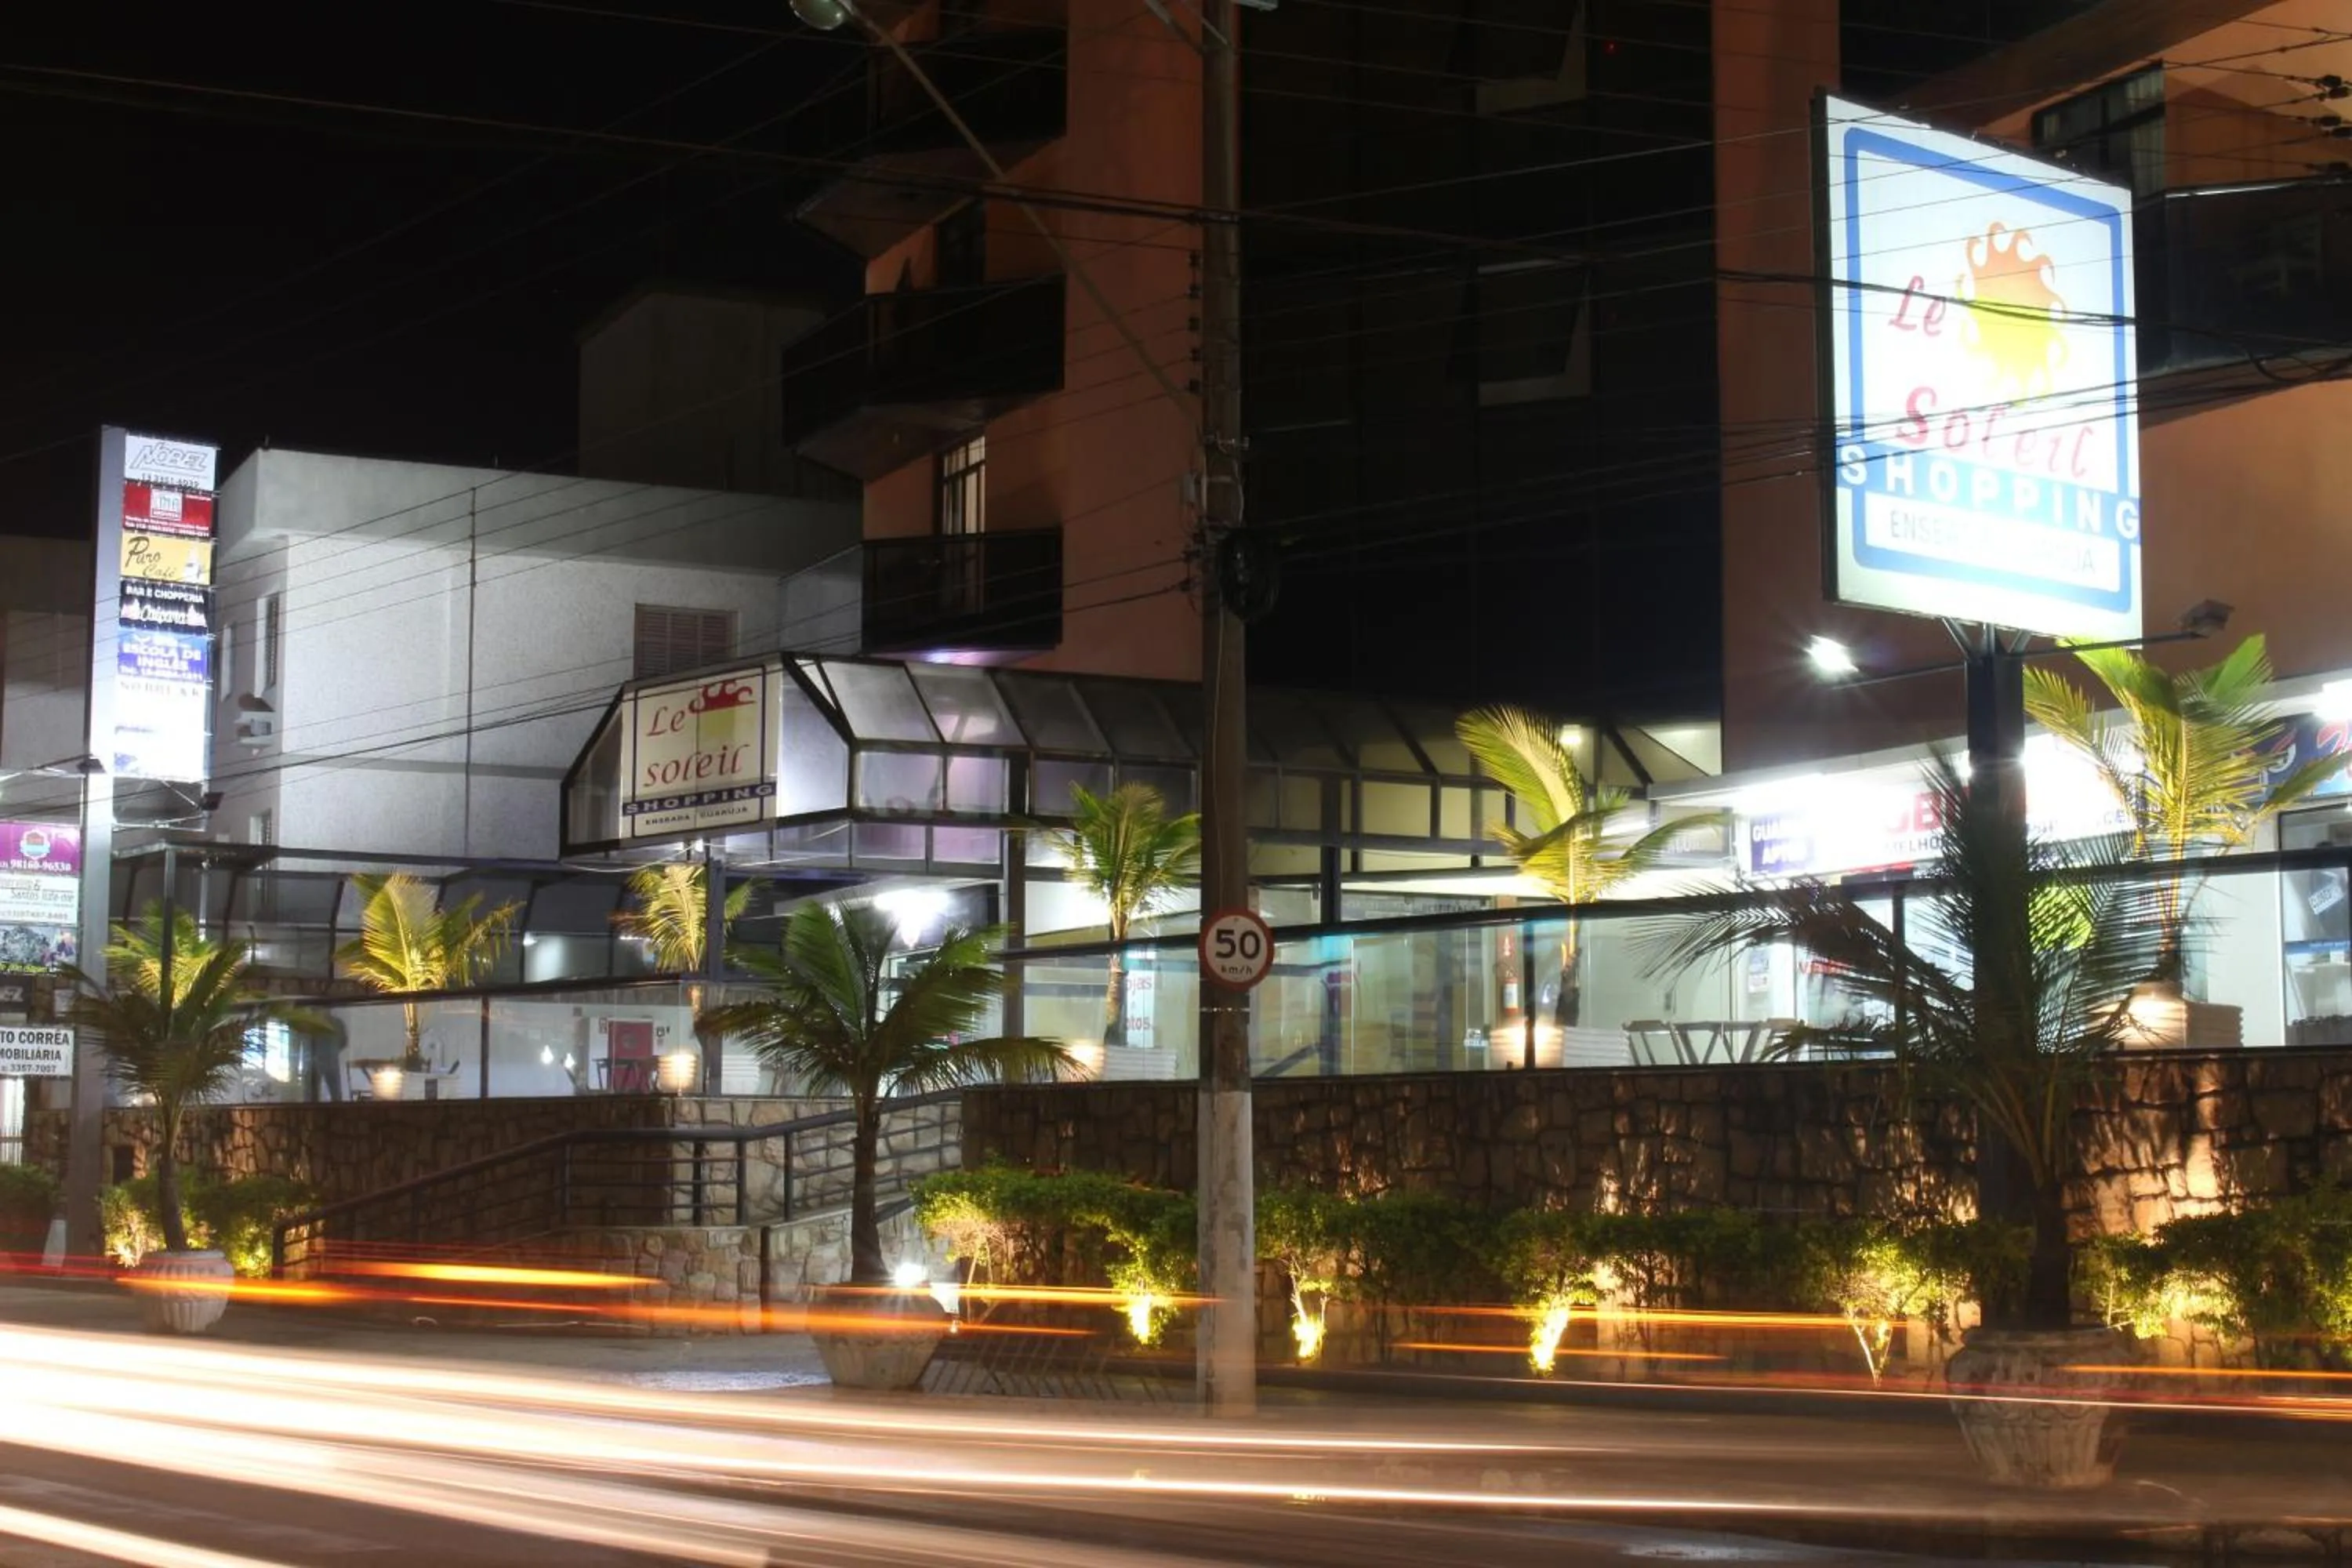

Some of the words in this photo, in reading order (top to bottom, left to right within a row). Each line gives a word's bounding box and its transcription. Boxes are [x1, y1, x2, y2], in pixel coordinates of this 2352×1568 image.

[1889, 275, 1947, 337] Le
[1895, 387, 2094, 477] Soleil
[1840, 445, 2139, 539] SHOPPING
[125, 536, 162, 568] Puro
[646, 706, 685, 737] Le
[626, 785, 773, 814] SHOPPING
[1215, 928, 1261, 960] 50
[1221, 964, 1253, 975] km/h
